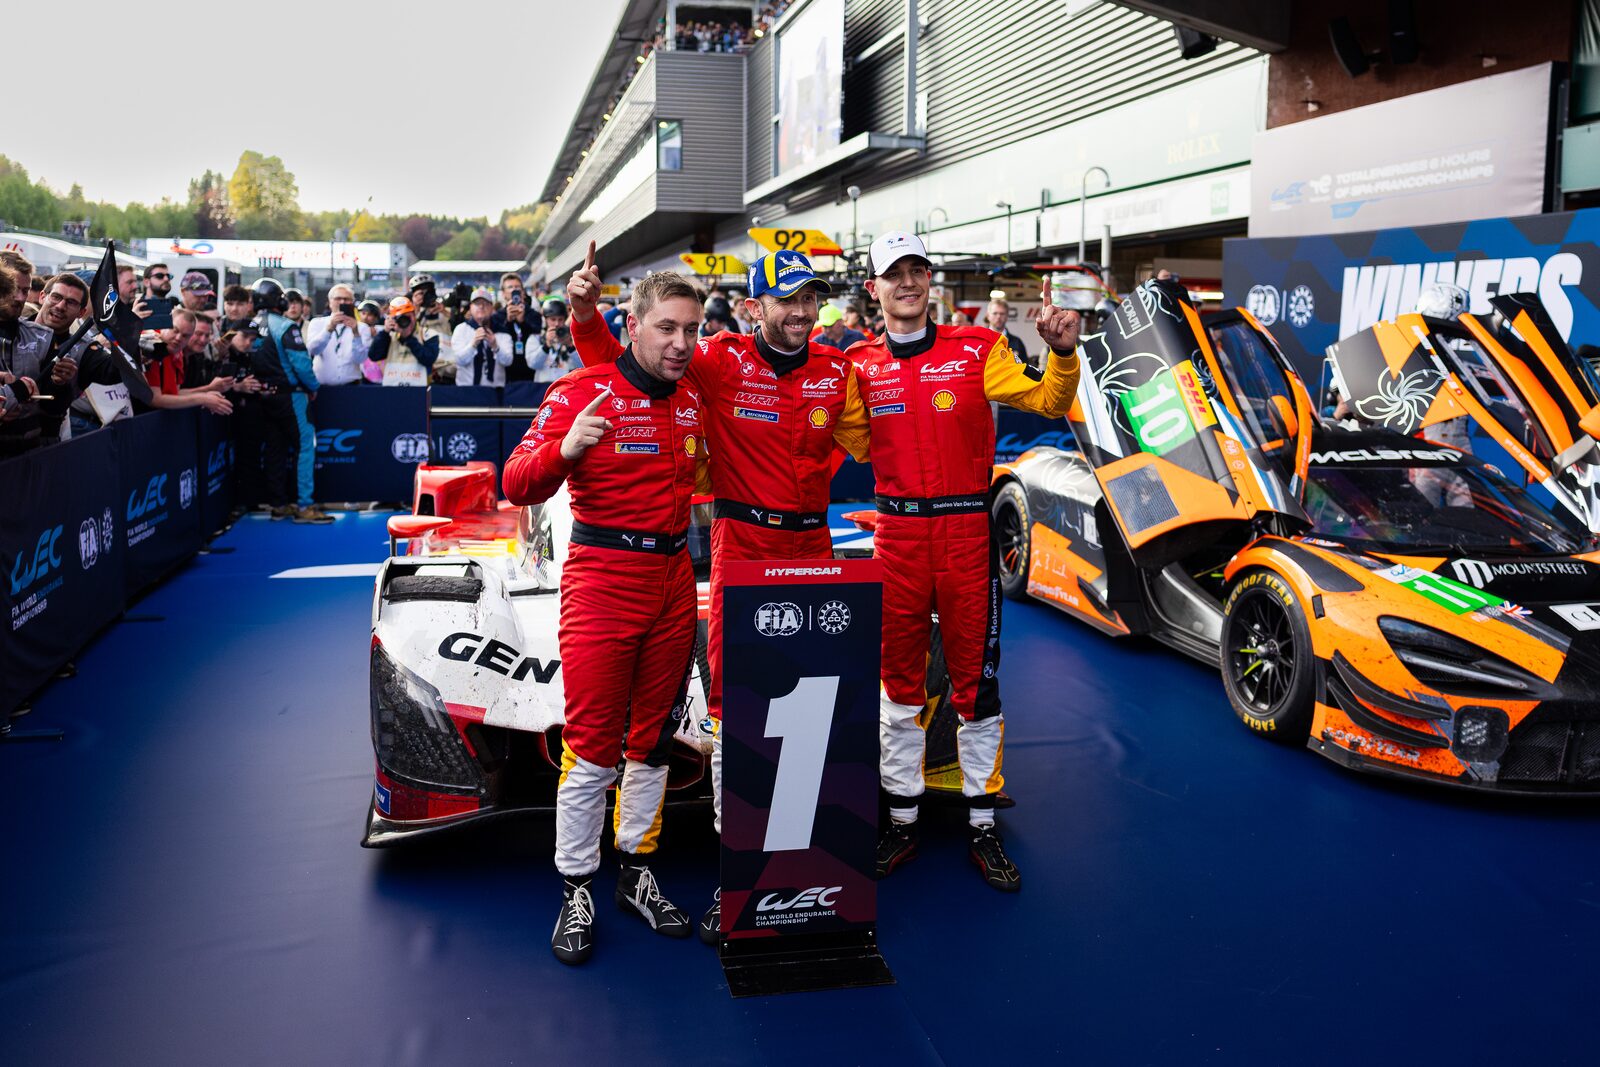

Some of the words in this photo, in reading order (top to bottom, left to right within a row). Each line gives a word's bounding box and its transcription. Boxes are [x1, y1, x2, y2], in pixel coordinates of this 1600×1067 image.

[1168, 133, 1221, 165] ROLEX
[1440, 149, 1491, 168] HOURS
[775, 230, 806, 254] 92
[706, 256, 727, 273] 91
[778, 266, 814, 278] MICHELIN
[921, 360, 969, 373] WEC
[742, 380, 777, 391] Motorsport
[801, 378, 839, 389] WEC
[870, 377, 900, 387] Motorsport
[735, 391, 779, 406] WRT
[869, 388, 904, 402] WRT
[1180, 372, 1207, 418] DHL
[619, 415, 652, 423] Motorsport
[675, 406, 698, 420] WEC
[746, 411, 775, 420] MICHELIN
[1130, 383, 1188, 447] 10
[615, 426, 657, 438] WRT
[1308, 449, 1463, 464] McLaren
[127, 473, 167, 521] WEC
[10, 524, 64, 596] WEC
[765, 567, 842, 577] HYPERCAR
[1491, 562, 1588, 576] MOUNTSTREET
[1231, 573, 1295, 607] GOODYEAR
[20, 593, 37, 611] WORLD
[1242, 712, 1277, 732] EAGLE
[763, 675, 840, 853] 1
[756, 886, 842, 911] WEC
[795, 910, 836, 918] ENDURANCE
[755, 918, 808, 927] CHAMPIONSHIP
